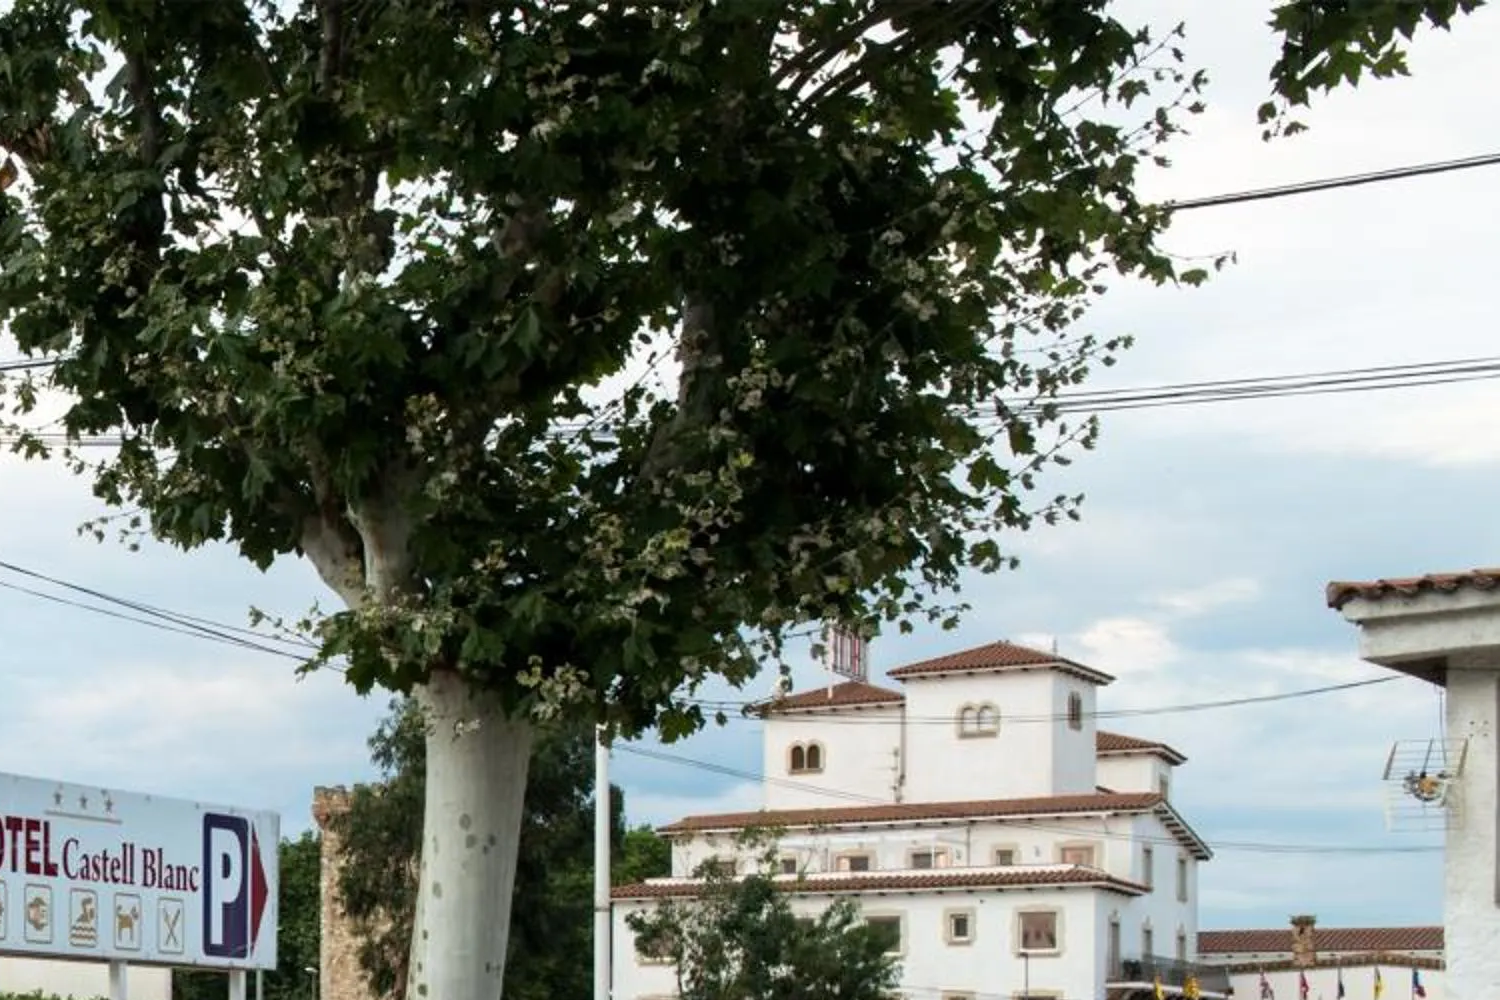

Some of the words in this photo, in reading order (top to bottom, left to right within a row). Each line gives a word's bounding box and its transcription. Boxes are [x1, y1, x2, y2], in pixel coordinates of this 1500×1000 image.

[63, 837, 135, 885] Castell
[143, 847, 200, 893] Blanc
[209, 826, 242, 946] P
